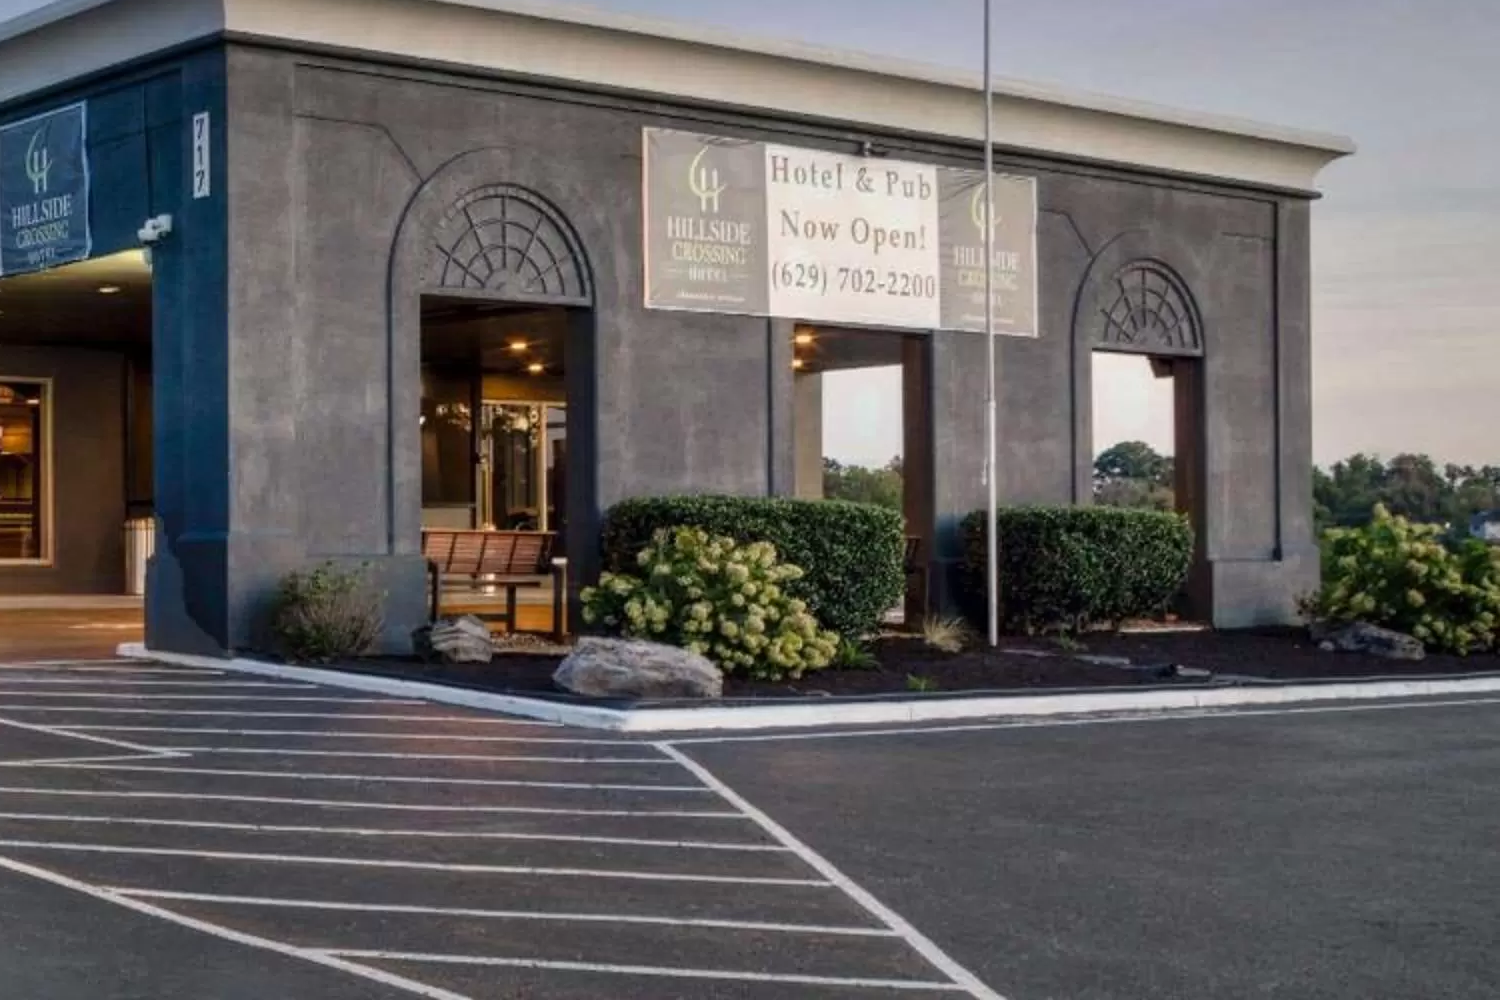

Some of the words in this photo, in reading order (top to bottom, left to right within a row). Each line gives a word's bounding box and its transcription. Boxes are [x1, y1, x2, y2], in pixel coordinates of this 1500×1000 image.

[771, 154, 844, 191] Hotel
[855, 166, 876, 194] &
[885, 170, 932, 201] Pub
[12, 193, 73, 230] HILLSIDE
[667, 215, 752, 246] HILLSIDE
[780, 208, 840, 242] Now
[851, 216, 926, 256] Open!
[954, 246, 1020, 271] HILLIDE
[772, 262, 828, 297] (629)
[837, 267, 935, 299] 702-2200
